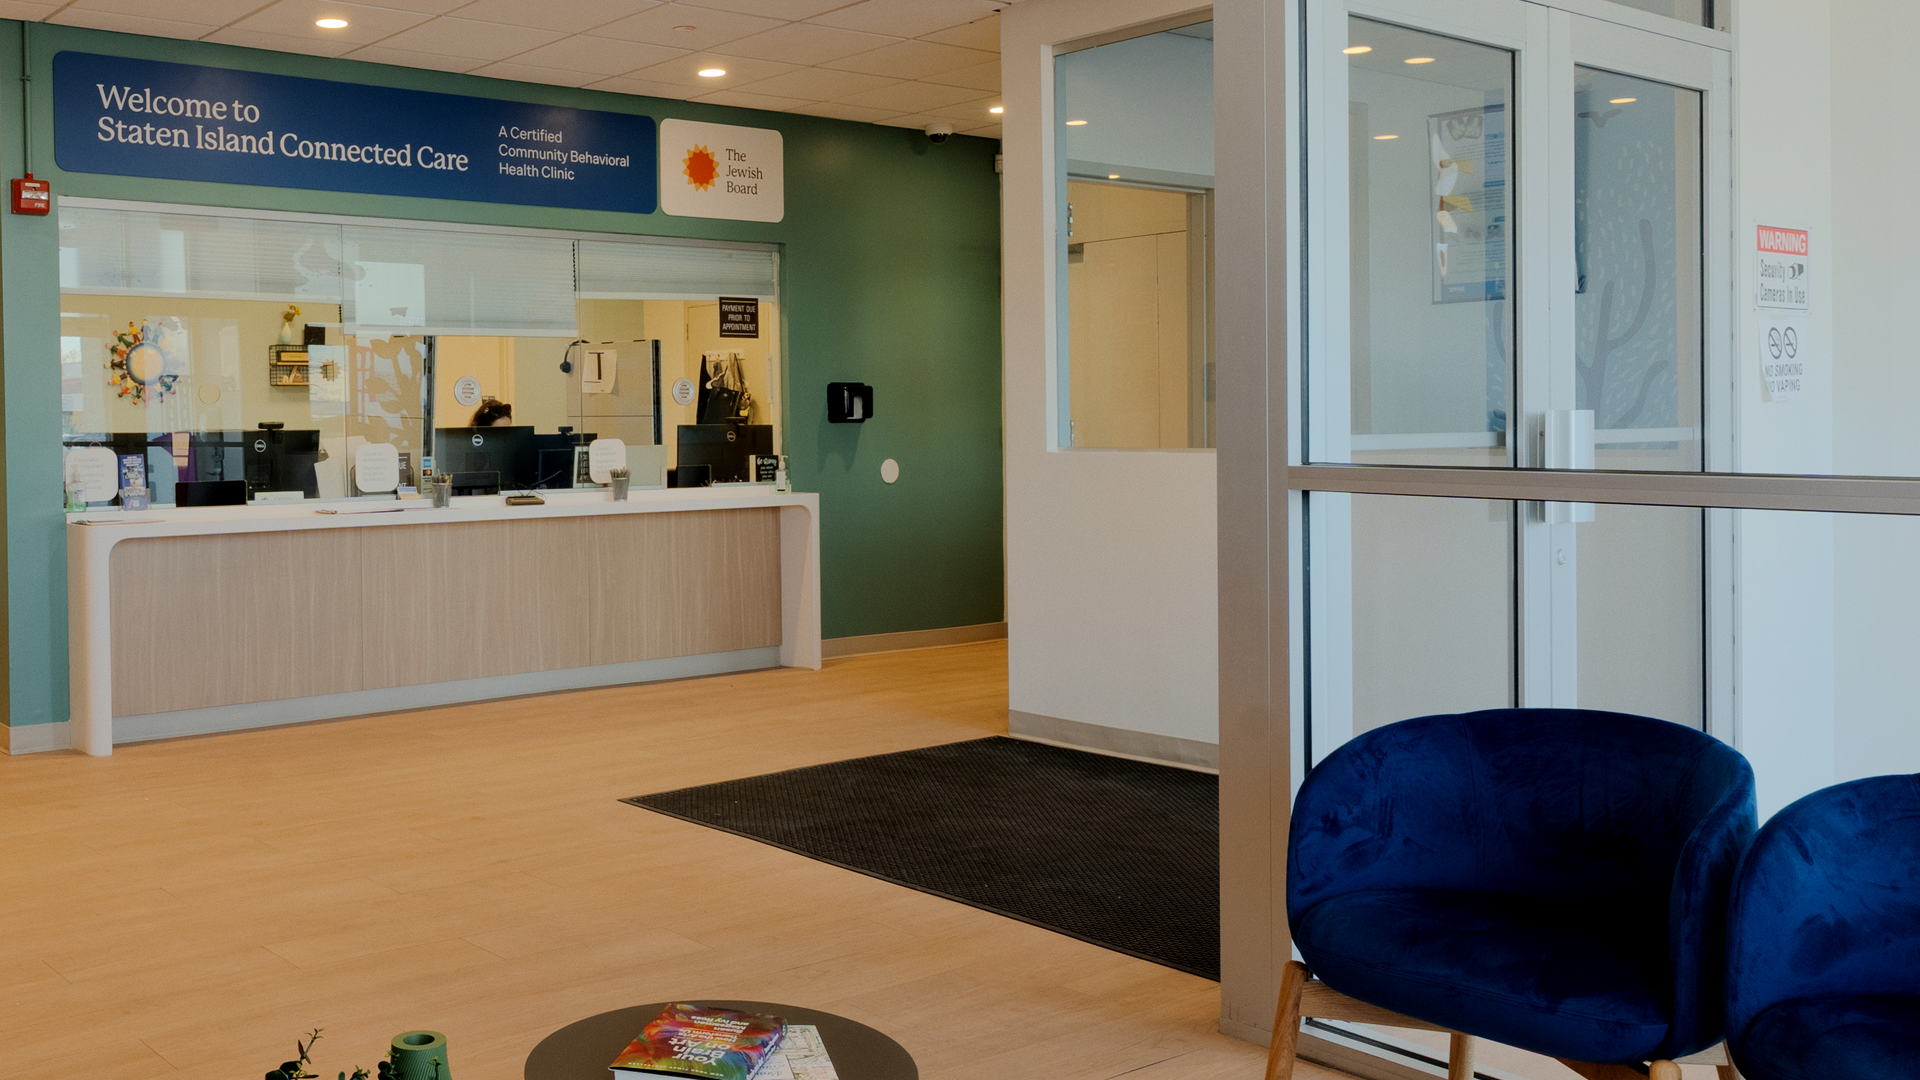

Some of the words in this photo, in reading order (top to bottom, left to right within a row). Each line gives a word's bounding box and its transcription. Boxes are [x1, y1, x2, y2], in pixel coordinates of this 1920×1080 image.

[96, 83, 228, 121] Welcome
[232, 100, 260, 124] to
[498, 126, 508, 138] A
[510, 126, 563, 144] Certified
[97, 116, 190, 149] Staten
[196, 124, 275, 156] Island
[279, 133, 413, 168] Connected
[416, 146, 469, 172] Care
[498, 144, 568, 163] Community
[570, 150, 630, 168] Behavioral
[726, 148, 747, 163] The
[499, 163, 539, 178] Health
[541, 166, 575, 181] Clinic
[725, 165, 763, 180] Jewish
[726, 181, 758, 196] Board
[1759, 229, 1807, 253] WARNING
[1760, 259, 1786, 283] Security
[1760, 283, 1786, 303] Cameras
[1787, 286, 1793, 304] In
[1794, 287, 1806, 304] Use
[722, 304, 745, 312] PAYMENT
[746, 305, 756, 313] DUE
[744, 314, 751, 322] TO
[722, 323, 756, 331] APPOINTMENT
[1765, 364, 1774, 377] NO
[1774, 363, 1803, 376] SMOKING
[1776, 379, 1801, 393] VAPING
[668, 1037, 703, 1049] Art
[705, 1042, 732, 1051] on
[672, 1045, 726, 1059] Brain
[672, 1053, 717, 1066] Your
